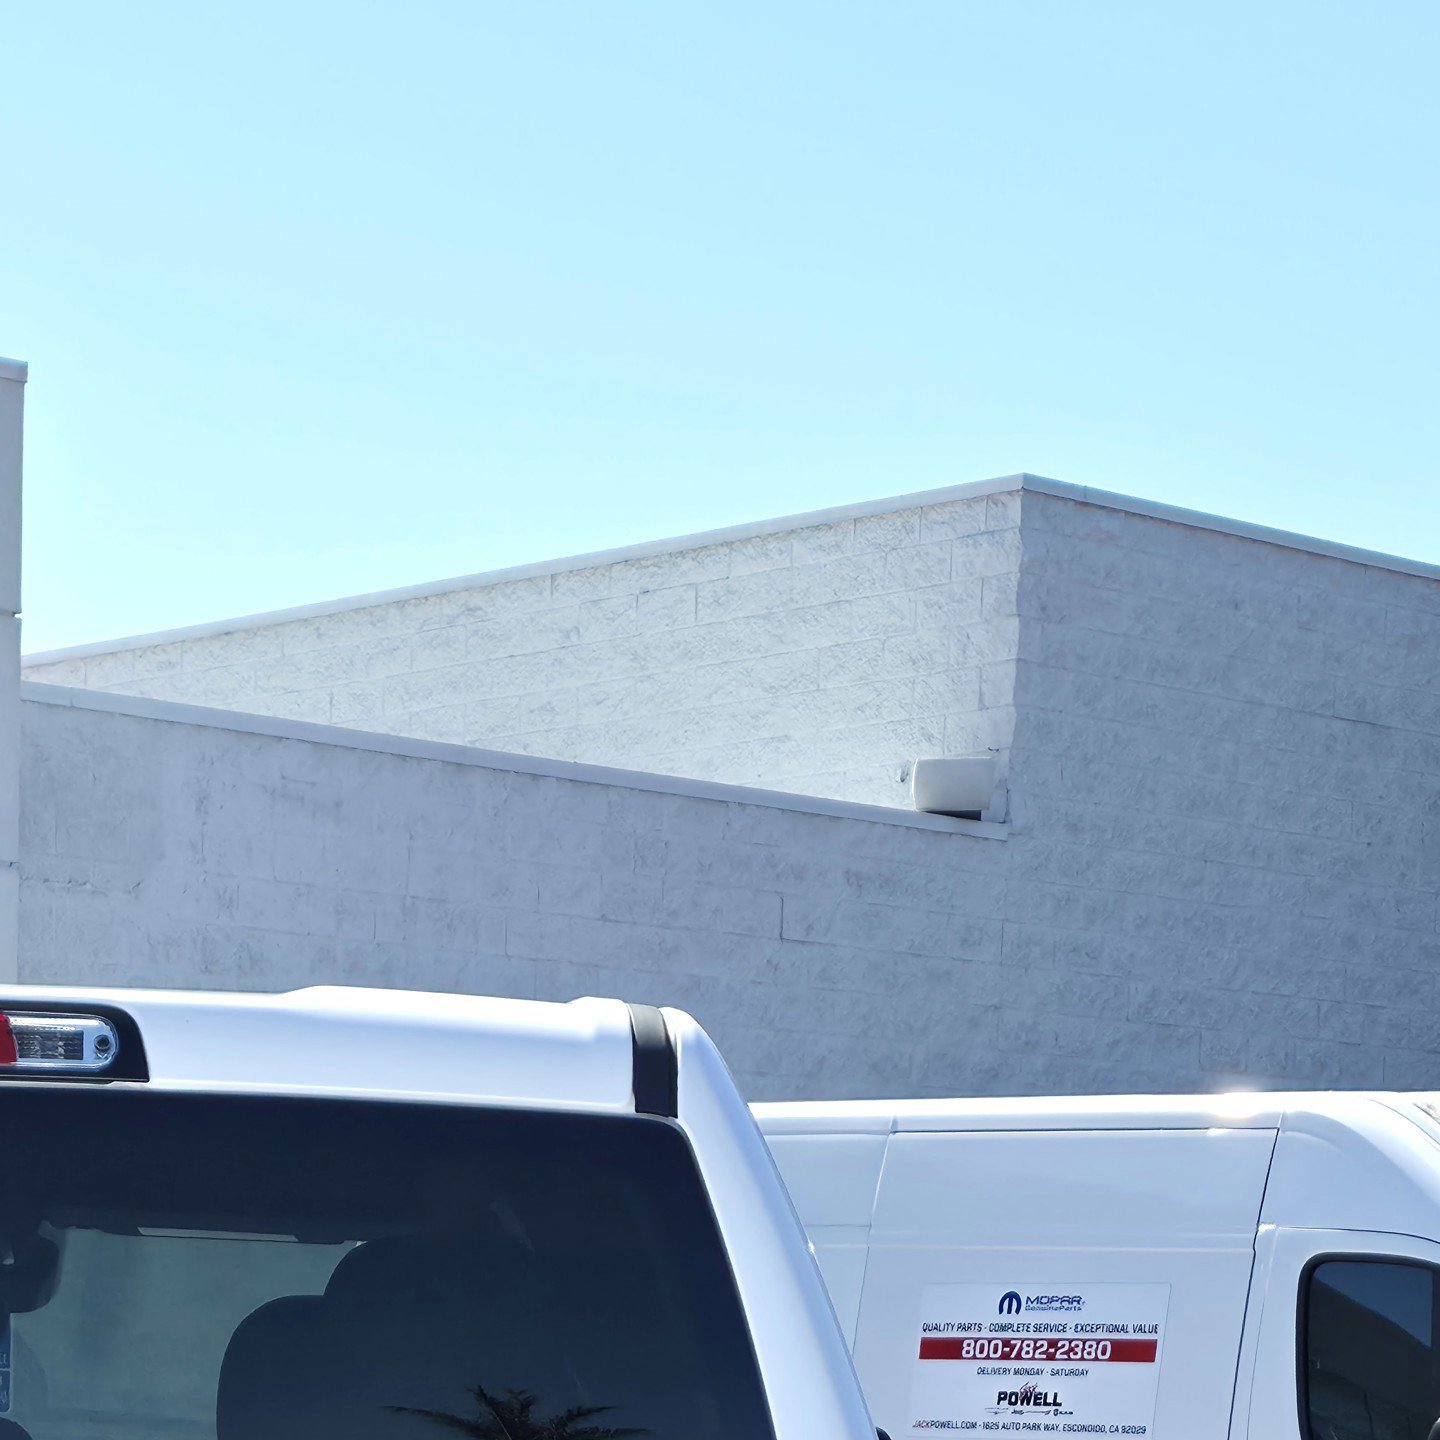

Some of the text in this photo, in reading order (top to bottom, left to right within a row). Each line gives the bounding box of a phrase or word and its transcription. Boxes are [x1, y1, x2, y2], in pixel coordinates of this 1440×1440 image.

[1025, 1295, 1083, 1305] MOPAR
[922, 1322, 1159, 1334] QUALITY PARTS COMPLETE SERVICE EXCEPTIONAL VALUE
[961, 1339, 1112, 1360] 800-782-2380
[977, 1366, 1089, 1377] DELIVERY MONDAY SATURDAY
[996, 1391, 1062, 1406] POWELL
[912, 1420, 978, 1430] JACKPOWELL.COM
[1001, 1421, 1021, 1430] AUTO
[1022, 1422, 1041, 1431] PARK
[1109, 1424, 1120, 1434] CA
